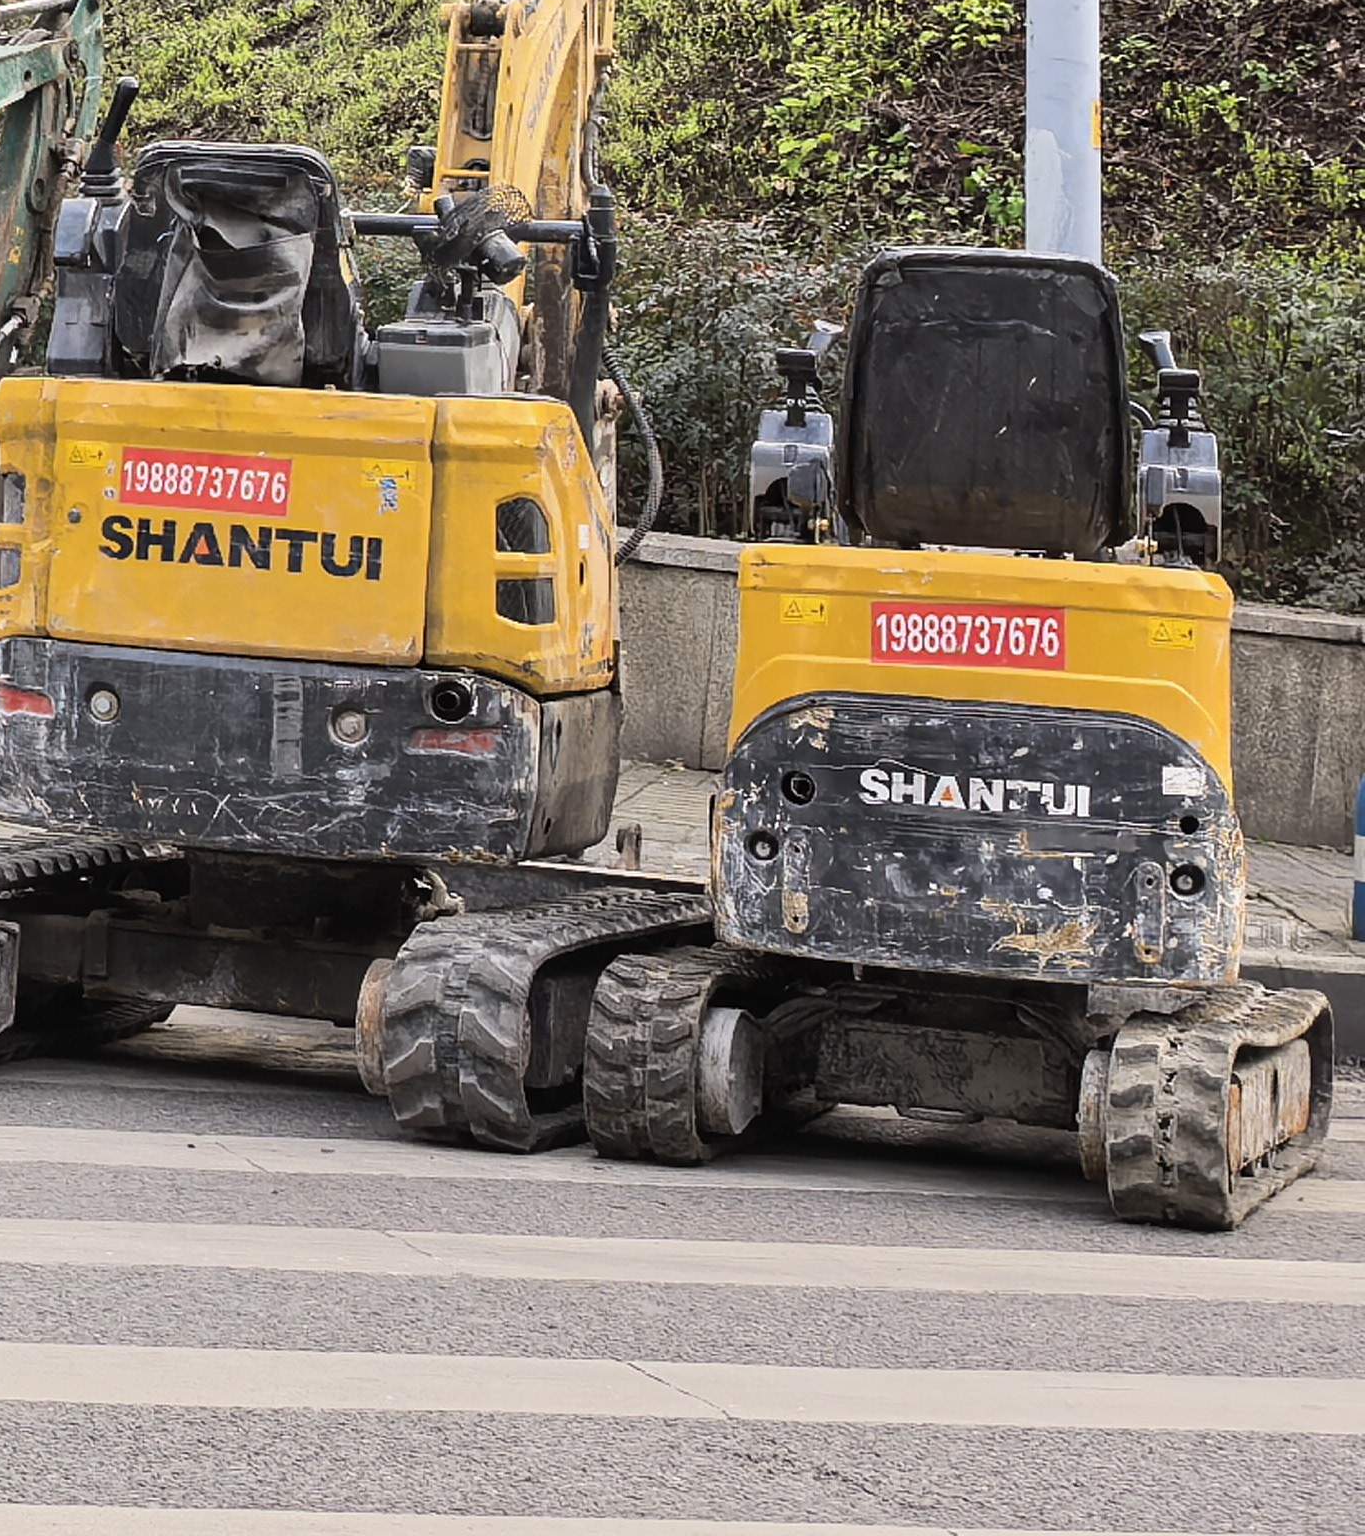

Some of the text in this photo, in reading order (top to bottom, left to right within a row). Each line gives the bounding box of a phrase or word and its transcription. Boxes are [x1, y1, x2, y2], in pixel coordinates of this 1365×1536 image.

[122, 459, 287, 505] 19888737676
[99, 515, 383, 581] SHANTUI
[875, 613, 1060, 657] 19888737676
[858, 768, 1091, 818] SHANTUI
